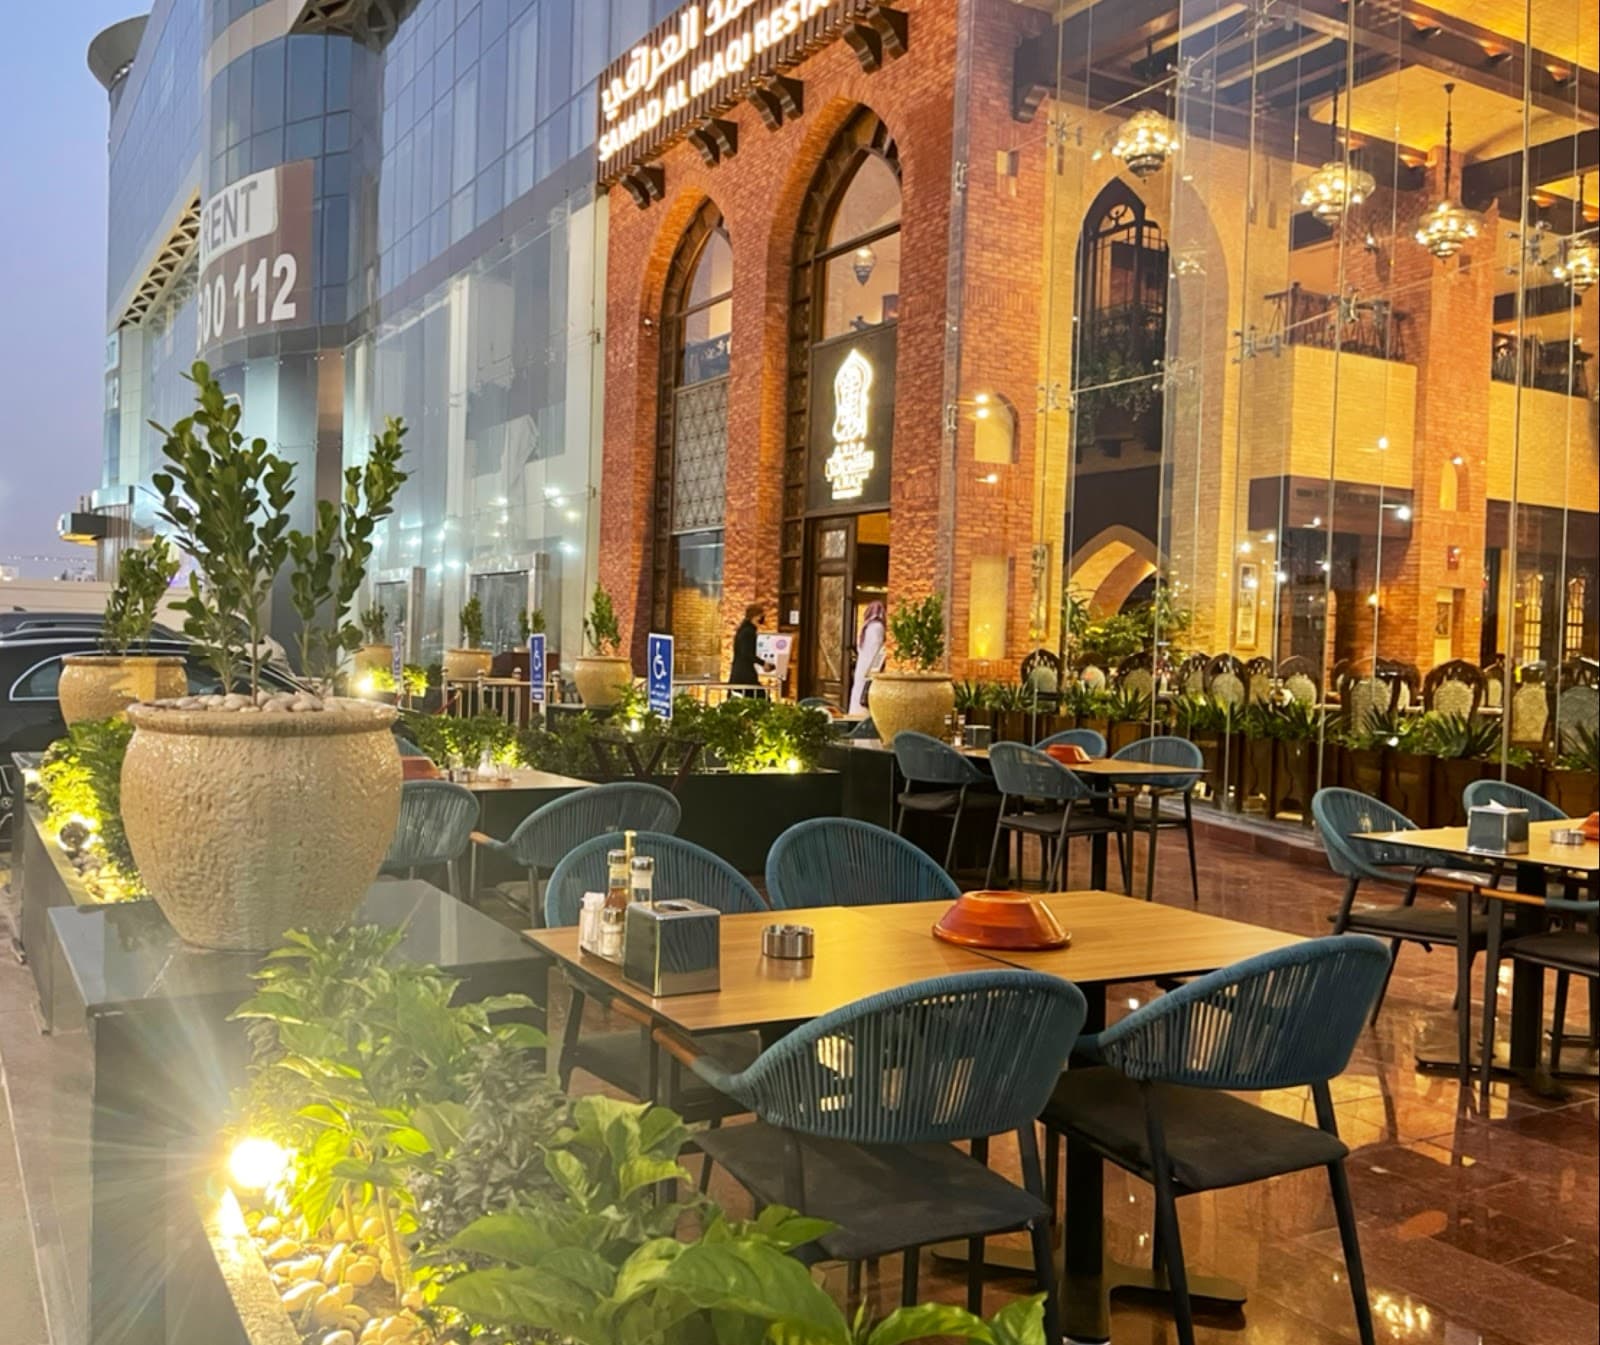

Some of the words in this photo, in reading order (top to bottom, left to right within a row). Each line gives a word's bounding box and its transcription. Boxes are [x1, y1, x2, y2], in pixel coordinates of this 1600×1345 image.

[598, 98, 662, 162] SAMAD
[663, 79, 690, 117] AL
[691, 32, 753, 97] IRAQI
[601, 5, 700, 121] العراقي
[203, 180, 257, 258] RENT
[234, 253, 297, 329] 112
